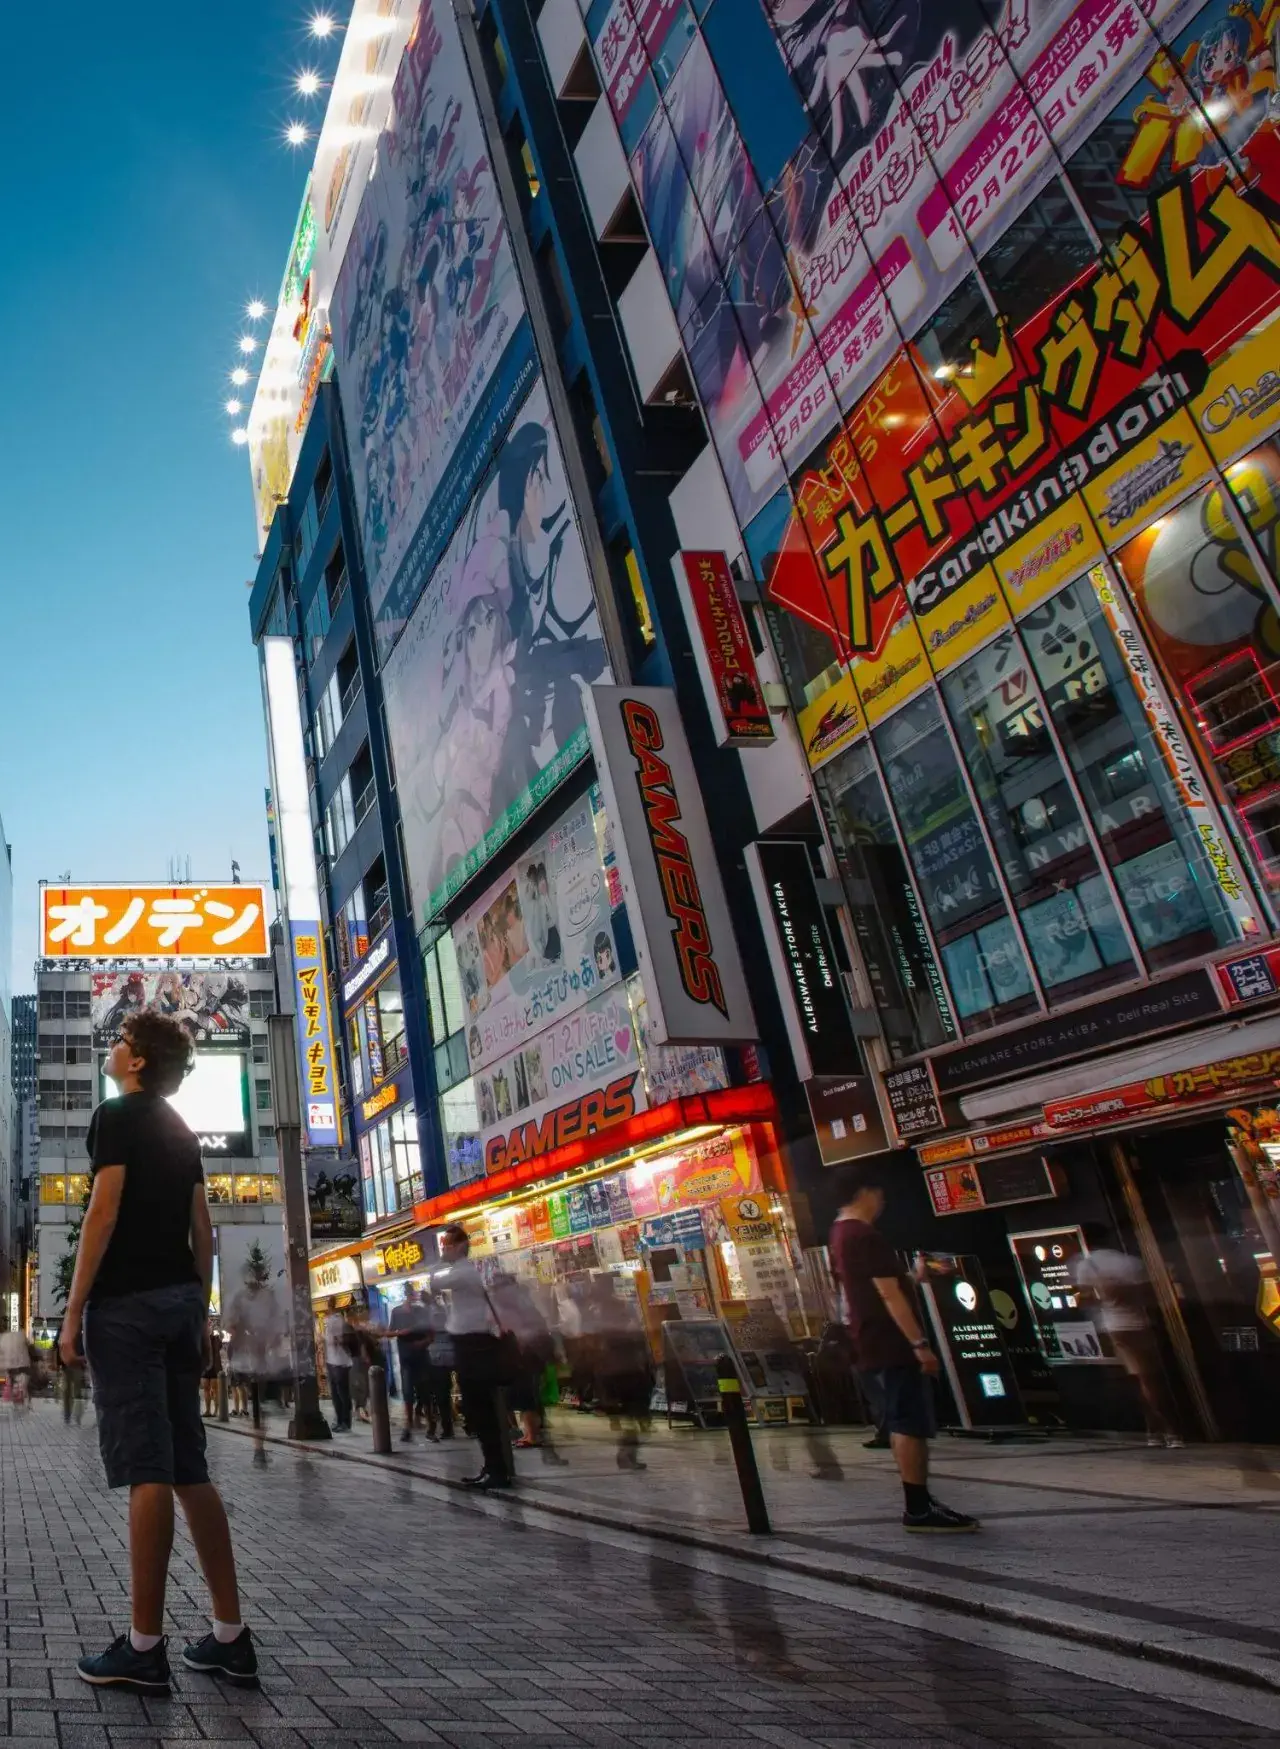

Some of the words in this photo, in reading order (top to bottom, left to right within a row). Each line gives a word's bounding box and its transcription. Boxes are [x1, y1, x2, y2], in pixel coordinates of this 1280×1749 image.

[622, 698, 730, 1021] GAMERS
[47, 889, 260, 947] オノデン
[773, 882, 790, 917] AKIBA
[295, 935, 317, 957] 薬
[783, 920, 800, 959] STORE
[810, 924, 821, 944] Site
[820, 966, 833, 987] Dell
[791, 962, 819, 1033] ALIENWARE
[948, 1049, 1011, 1076] ALIENWARE
[1016, 1033, 1055, 1056] STORE
[1059, 1021, 1099, 1042] AKIBA
[1117, 1007, 1141, 1024] Dell
[1142, 999, 1170, 1019] Real
[1172, 990, 1200, 1009] Site
[551, 1062, 573, 1089] ON
[574, 1033, 617, 1079] SALE
[484, 1069, 643, 1176] GAMERS
[952, 1324, 995, 1332] ALIENWARE
[954, 1333, 980, 1341] STORE
